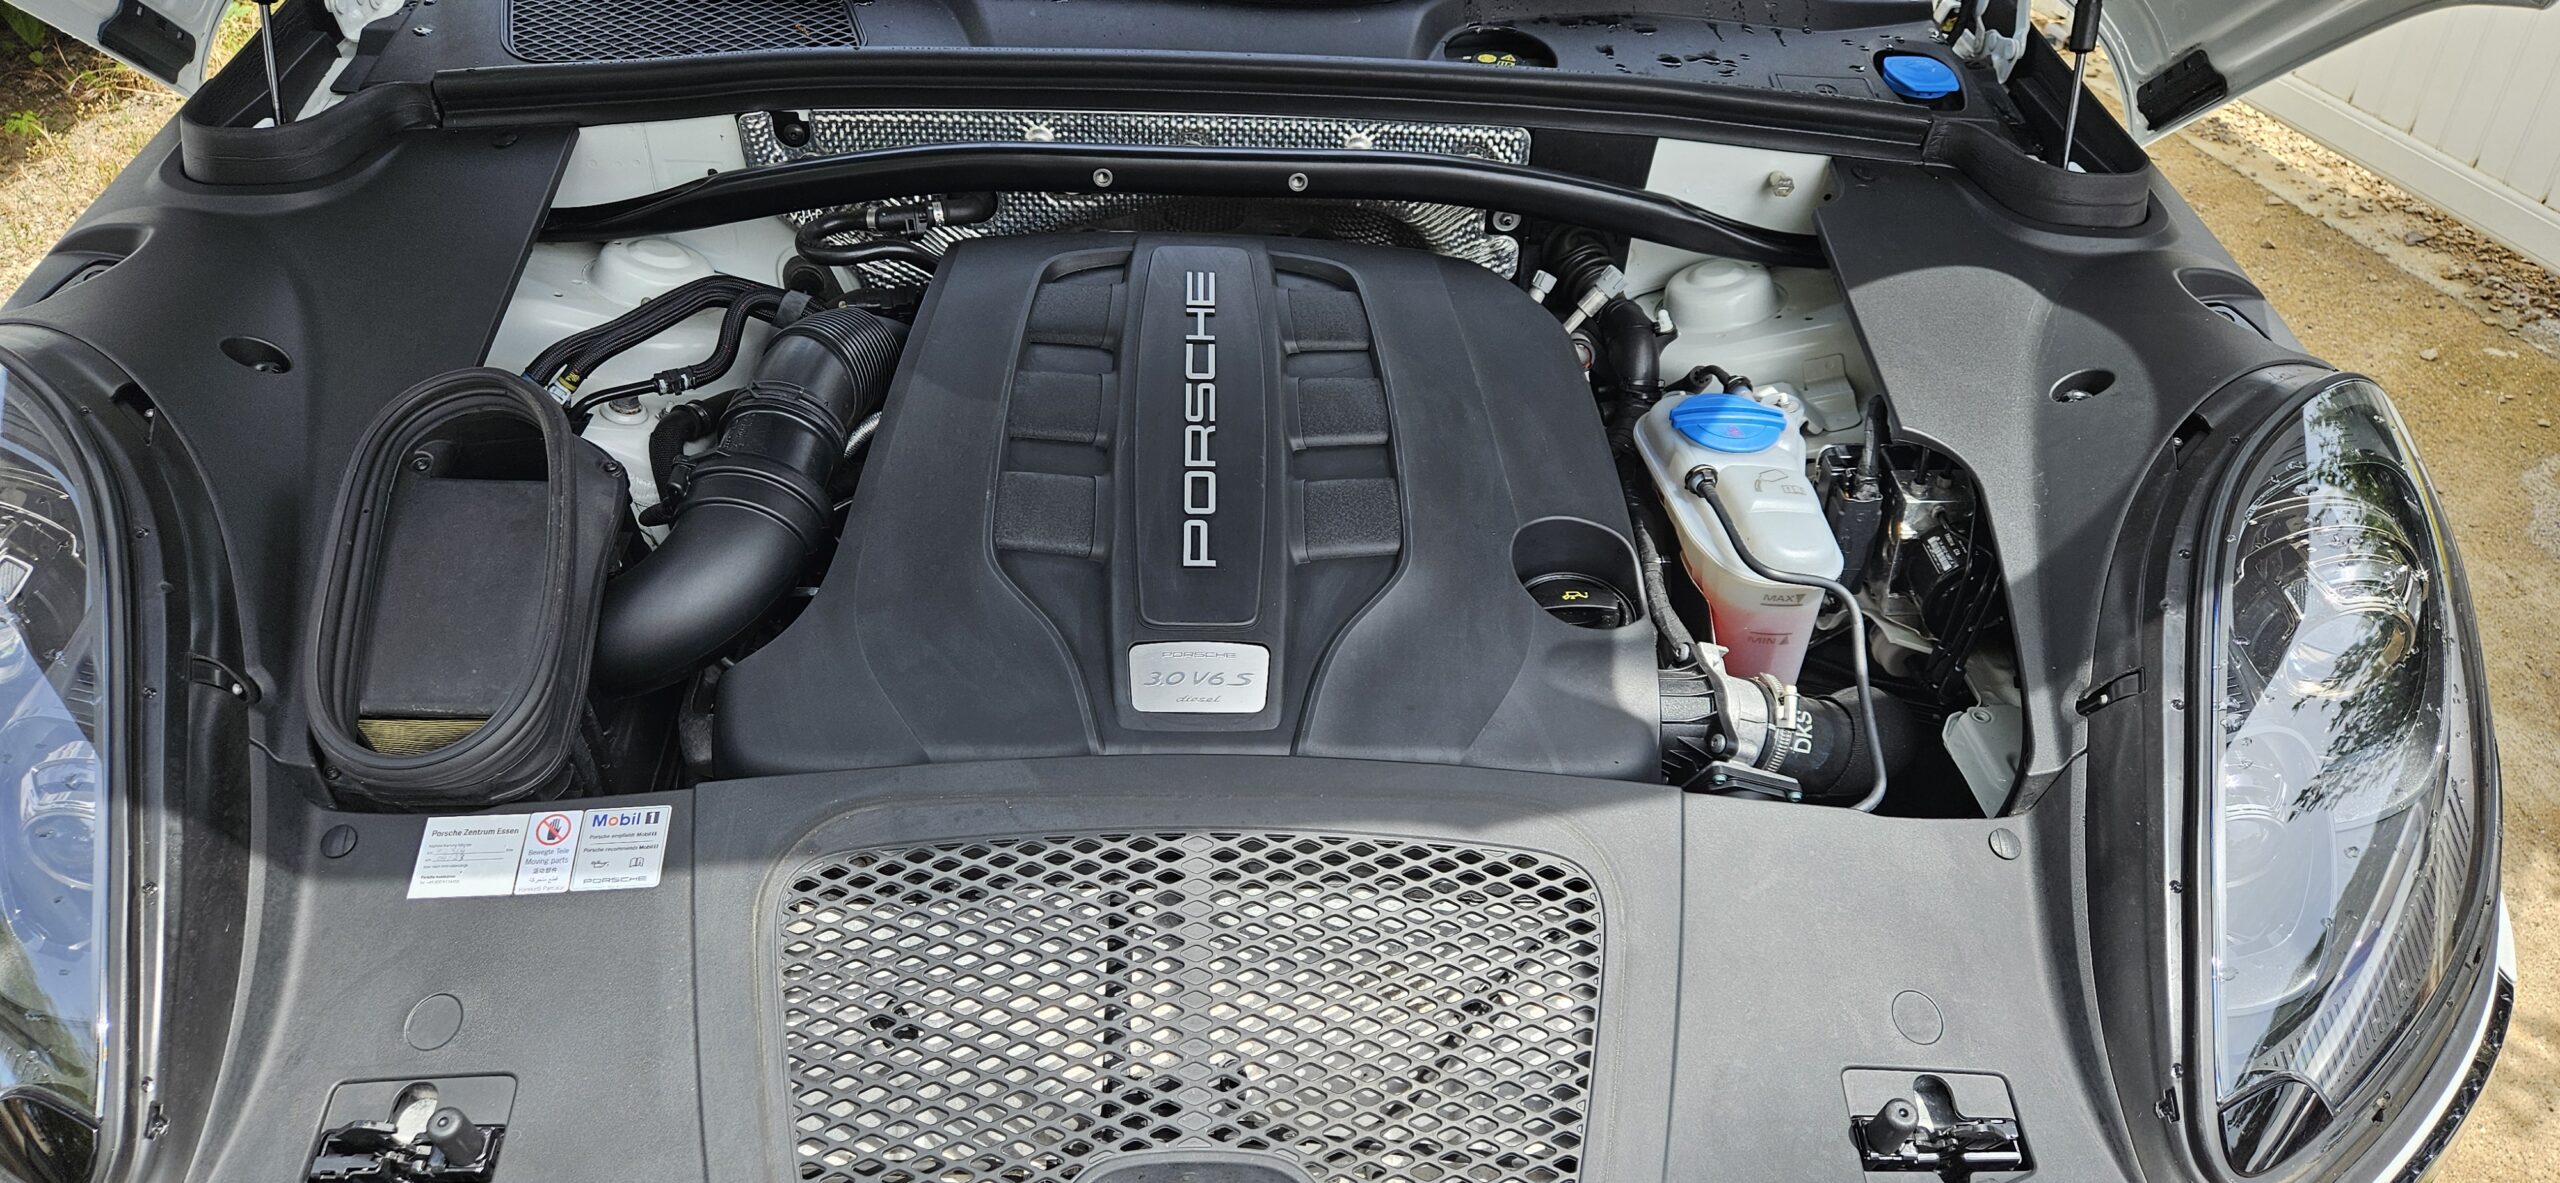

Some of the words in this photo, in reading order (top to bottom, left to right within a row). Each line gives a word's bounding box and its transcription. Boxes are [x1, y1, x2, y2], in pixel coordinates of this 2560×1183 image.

[1183, 271, 1216, 567] PORSCHE
[1763, 594, 1795, 602] MAX
[1747, 636, 1777, 645] MIN
[1193, 671, 1225, 686] V6
[1226, 672, 1255, 686] S
[1175, 695, 1222, 703] diesel
[1793, 710, 1813, 754] DKS
[592, 812, 641, 828] Mobil
[432, 829, 462, 837] Porsche
[463, 828, 495, 836] Zentrum
[496, 827, 519, 835] Essen
[550, 857, 569, 865] parts
[583, 875, 647, 884] PORSCHE
